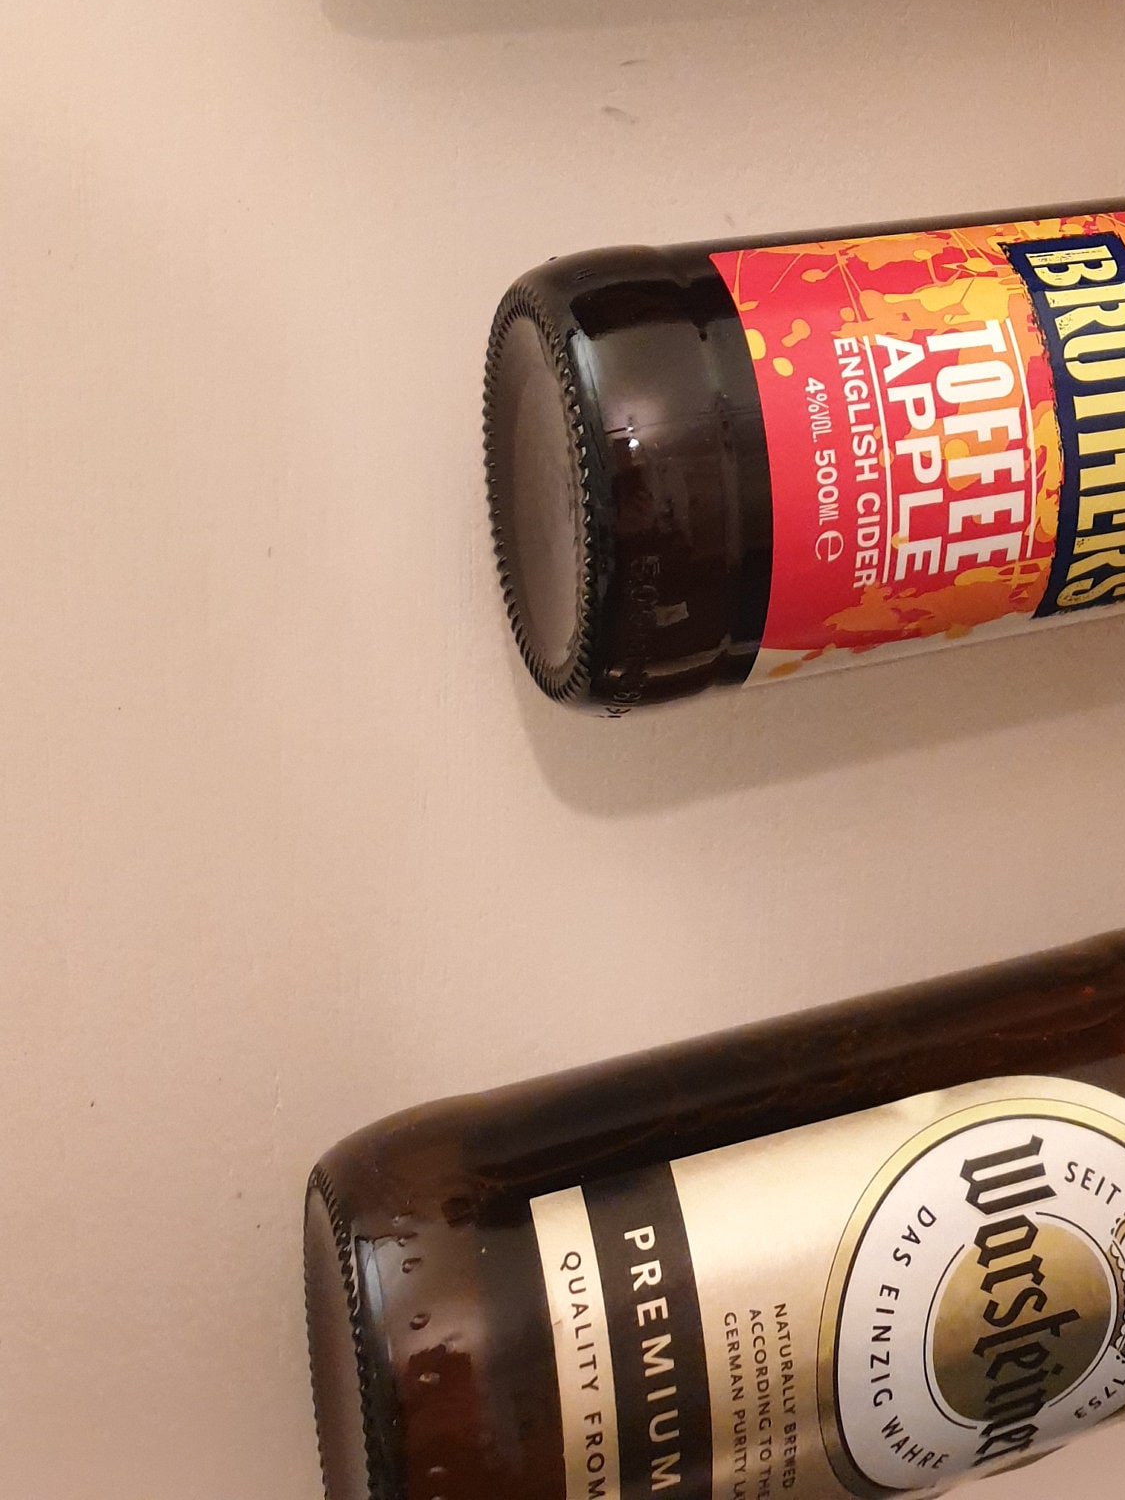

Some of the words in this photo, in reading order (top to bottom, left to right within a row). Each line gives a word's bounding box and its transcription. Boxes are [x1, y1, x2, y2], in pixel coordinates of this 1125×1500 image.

[833, 337, 880, 483] ENGLISH
[927, 319, 1026, 573] TOFFEE
[814, 449, 839, 526] 500ML
[874, 333, 944, 582] APPLE
[852, 491, 882, 589] CIDER
[1063, 1160, 1122, 1205] SEIT
[892, 1205, 938, 1268] DAS
[560, 1251, 600, 1392] QUALITY
[583, 1411, 606, 1500] FROM
[623, 1225, 681, 1492] PREMIUM
[724, 1311, 745, 1402] GERMAN
[749, 1308, 773, 1431] ACCORDING
[774, 1302, 796, 1416] NATURALLY
[869, 1283, 900, 1408] EINZIG
[732, 1408, 747, 1474] PURITY
[757, 1470, 772, 1500] THE
[759, 1436, 773, 1461] TO
[782, 1422, 797, 1490] BREWED
[881, 1415, 950, 1471] WAHRE
